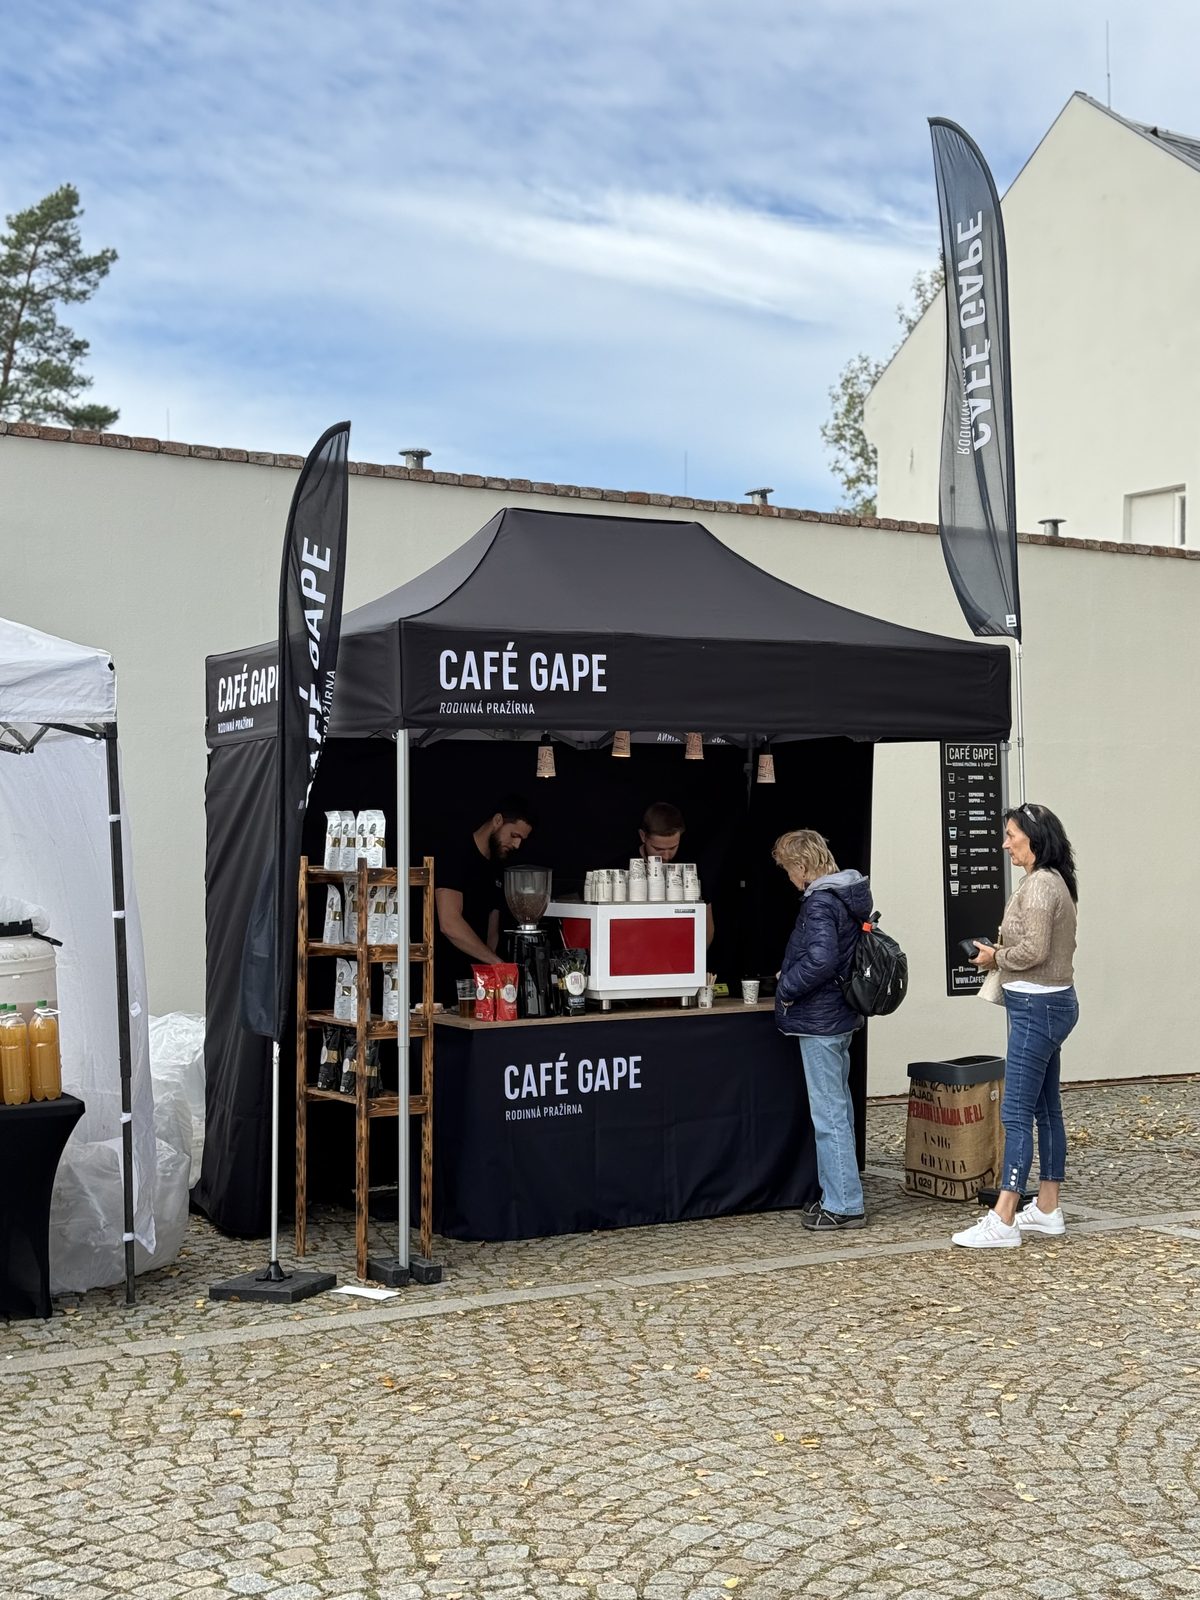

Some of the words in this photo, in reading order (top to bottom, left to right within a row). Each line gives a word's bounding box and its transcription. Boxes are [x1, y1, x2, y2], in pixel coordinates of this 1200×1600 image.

[300, 536, 331, 671] GAPE
[217, 663, 249, 713] CAFÉ
[438, 641, 520, 692] CAFÉ
[529, 651, 608, 693] GAPE
[439, 699, 484, 715] RODINNÁ
[486, 699, 536, 716] PRAŽÍRNA
[949, 745, 971, 760] CAFÉ
[972, 748, 995, 760] GAPE
[504, 1052, 569, 1101] CAFÉ
[577, 1055, 642, 1094] GAPE
[505, 1105, 542, 1121] RODINNÁ
[543, 1102, 584, 1118] PRAŽÍRNA
